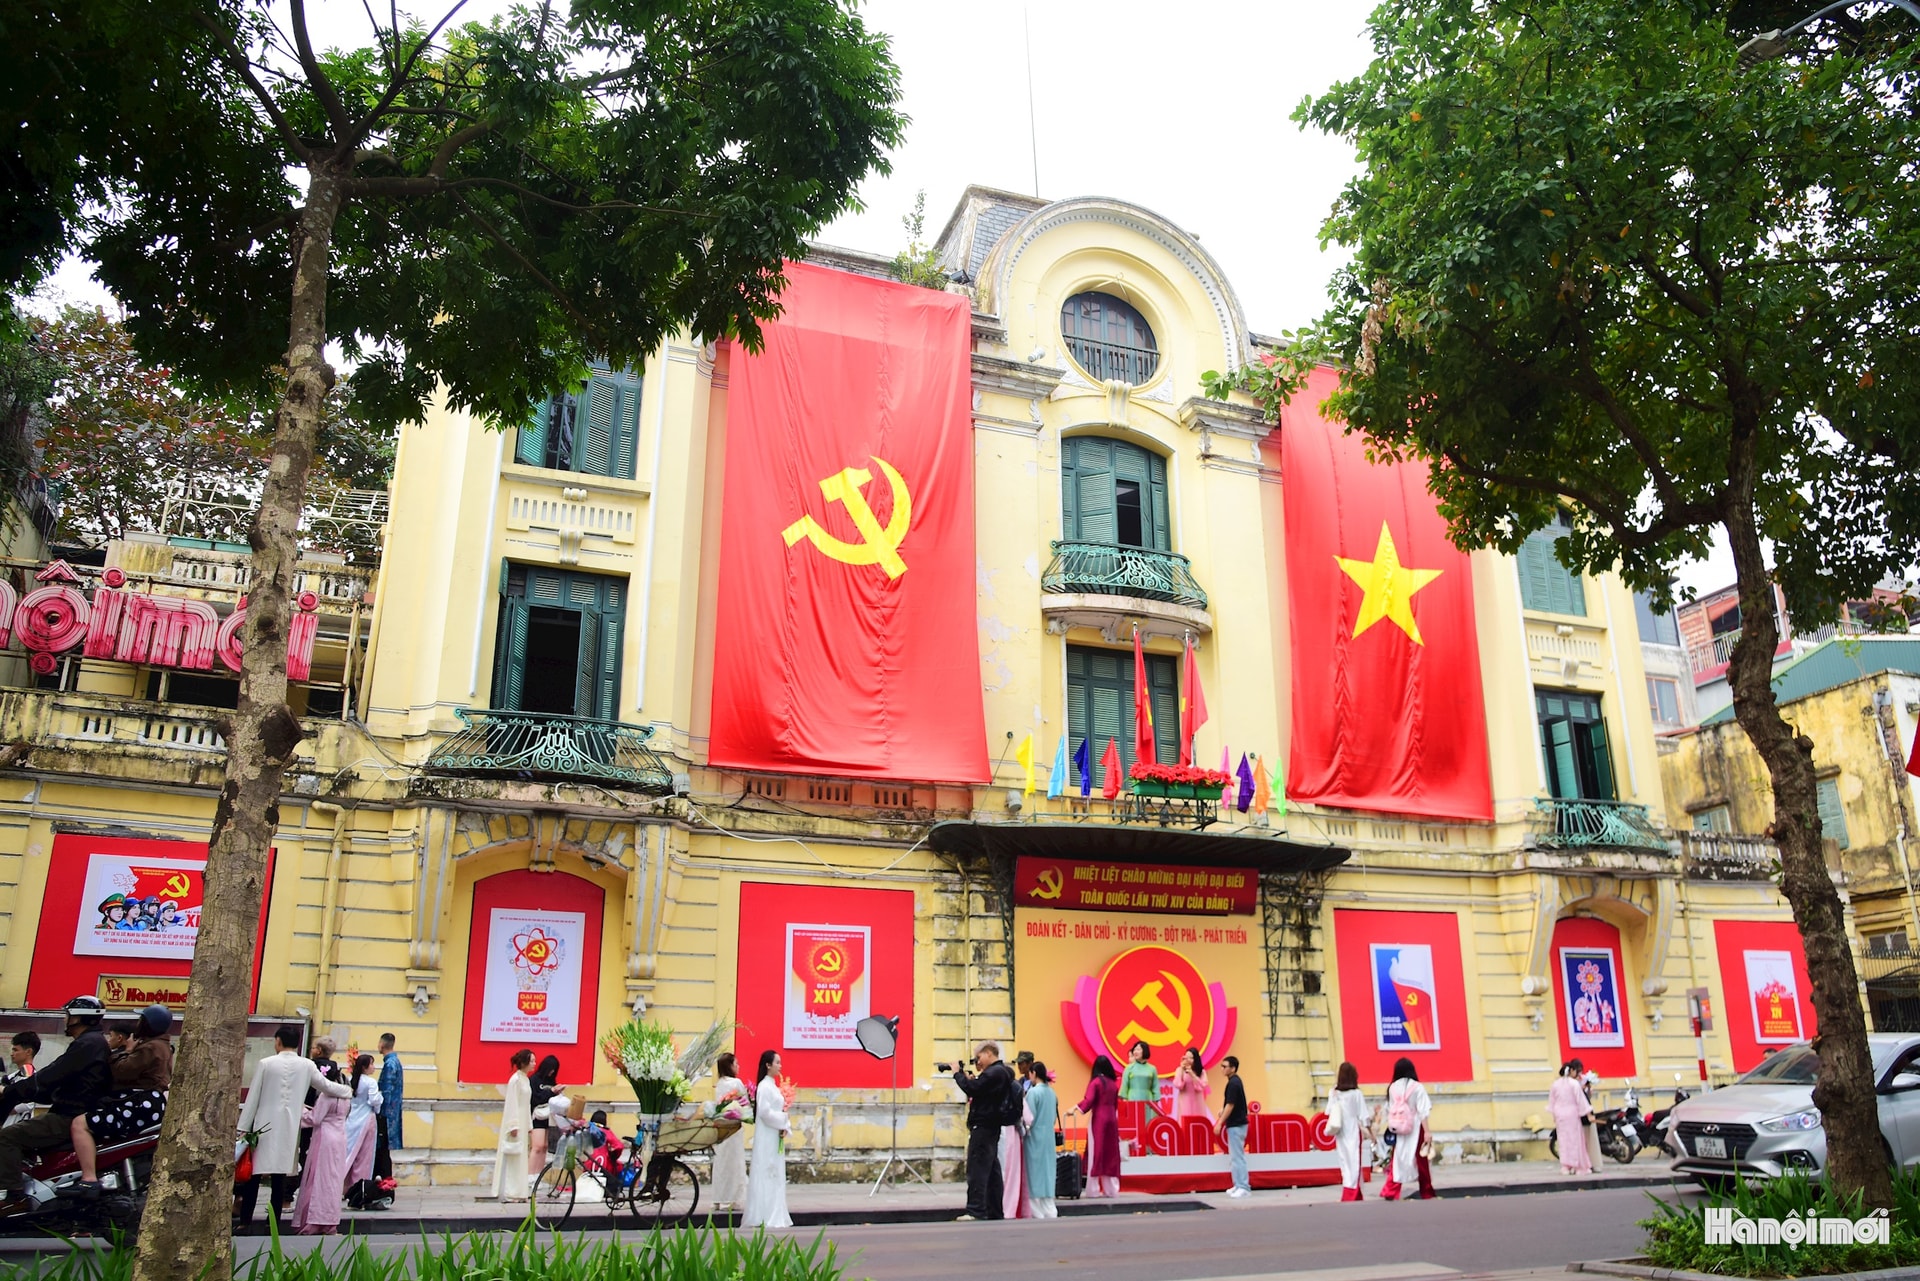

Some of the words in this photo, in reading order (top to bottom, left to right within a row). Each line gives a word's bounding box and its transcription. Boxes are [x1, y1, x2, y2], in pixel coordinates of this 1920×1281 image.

[0, 558, 319, 681] ộimi
[1073, 864, 1100, 883] NHIỆT
[1101, 865, 1120, 884] LIỆT
[1121, 867, 1146, 883] CHÀO
[1147, 869, 1175, 885] MỪNG
[1176, 872, 1191, 888] ĐẠI
[1193, 871, 1208, 889] HỘI
[1209, 873, 1224, 889] ĐẠI
[1080, 888, 1104, 905] TOÀN
[1105, 889, 1130, 905] QUỐC
[1151, 892, 1169, 908] THỨ
[1170, 895, 1185, 908] XIV
[1187, 892, 1203, 909] CỦA
[1205, 893, 1229, 910] ĐẢNG
[185, 914, 201, 927] XI
[1027, 919, 1050, 937] ĐOÀN
[1052, 918, 1067, 938] KẾT
[1075, 921, 1092, 939] DÂN
[1094, 920, 1110, 939] CHỦ
[1130, 925, 1157, 941] CƯƠNG
[1164, 924, 1179, 945] ĐỘT
[1181, 925, 1197, 943] PHÁ
[1203, 926, 1223, 943] PHÁT
[125, 987, 188, 1004] Hànộim
[813, 989, 843, 1004] XIV
[521, 1001, 545, 1010] XIV
